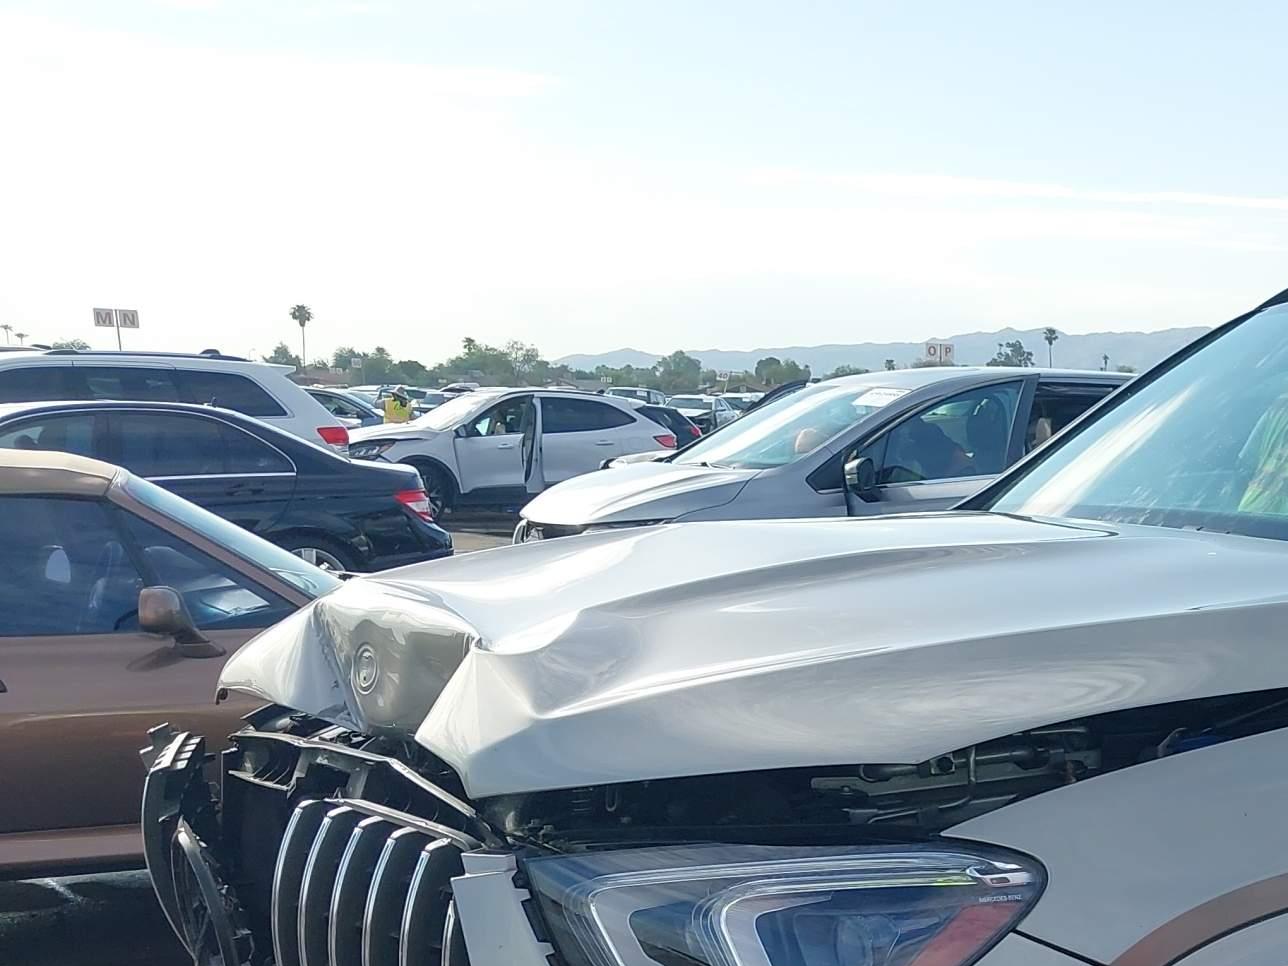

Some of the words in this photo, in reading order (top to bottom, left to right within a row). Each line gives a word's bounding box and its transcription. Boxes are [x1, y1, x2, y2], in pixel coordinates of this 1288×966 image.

[95, 311, 112, 325] M
[122, 312, 136, 326] N
[944, 346, 952, 356] P
